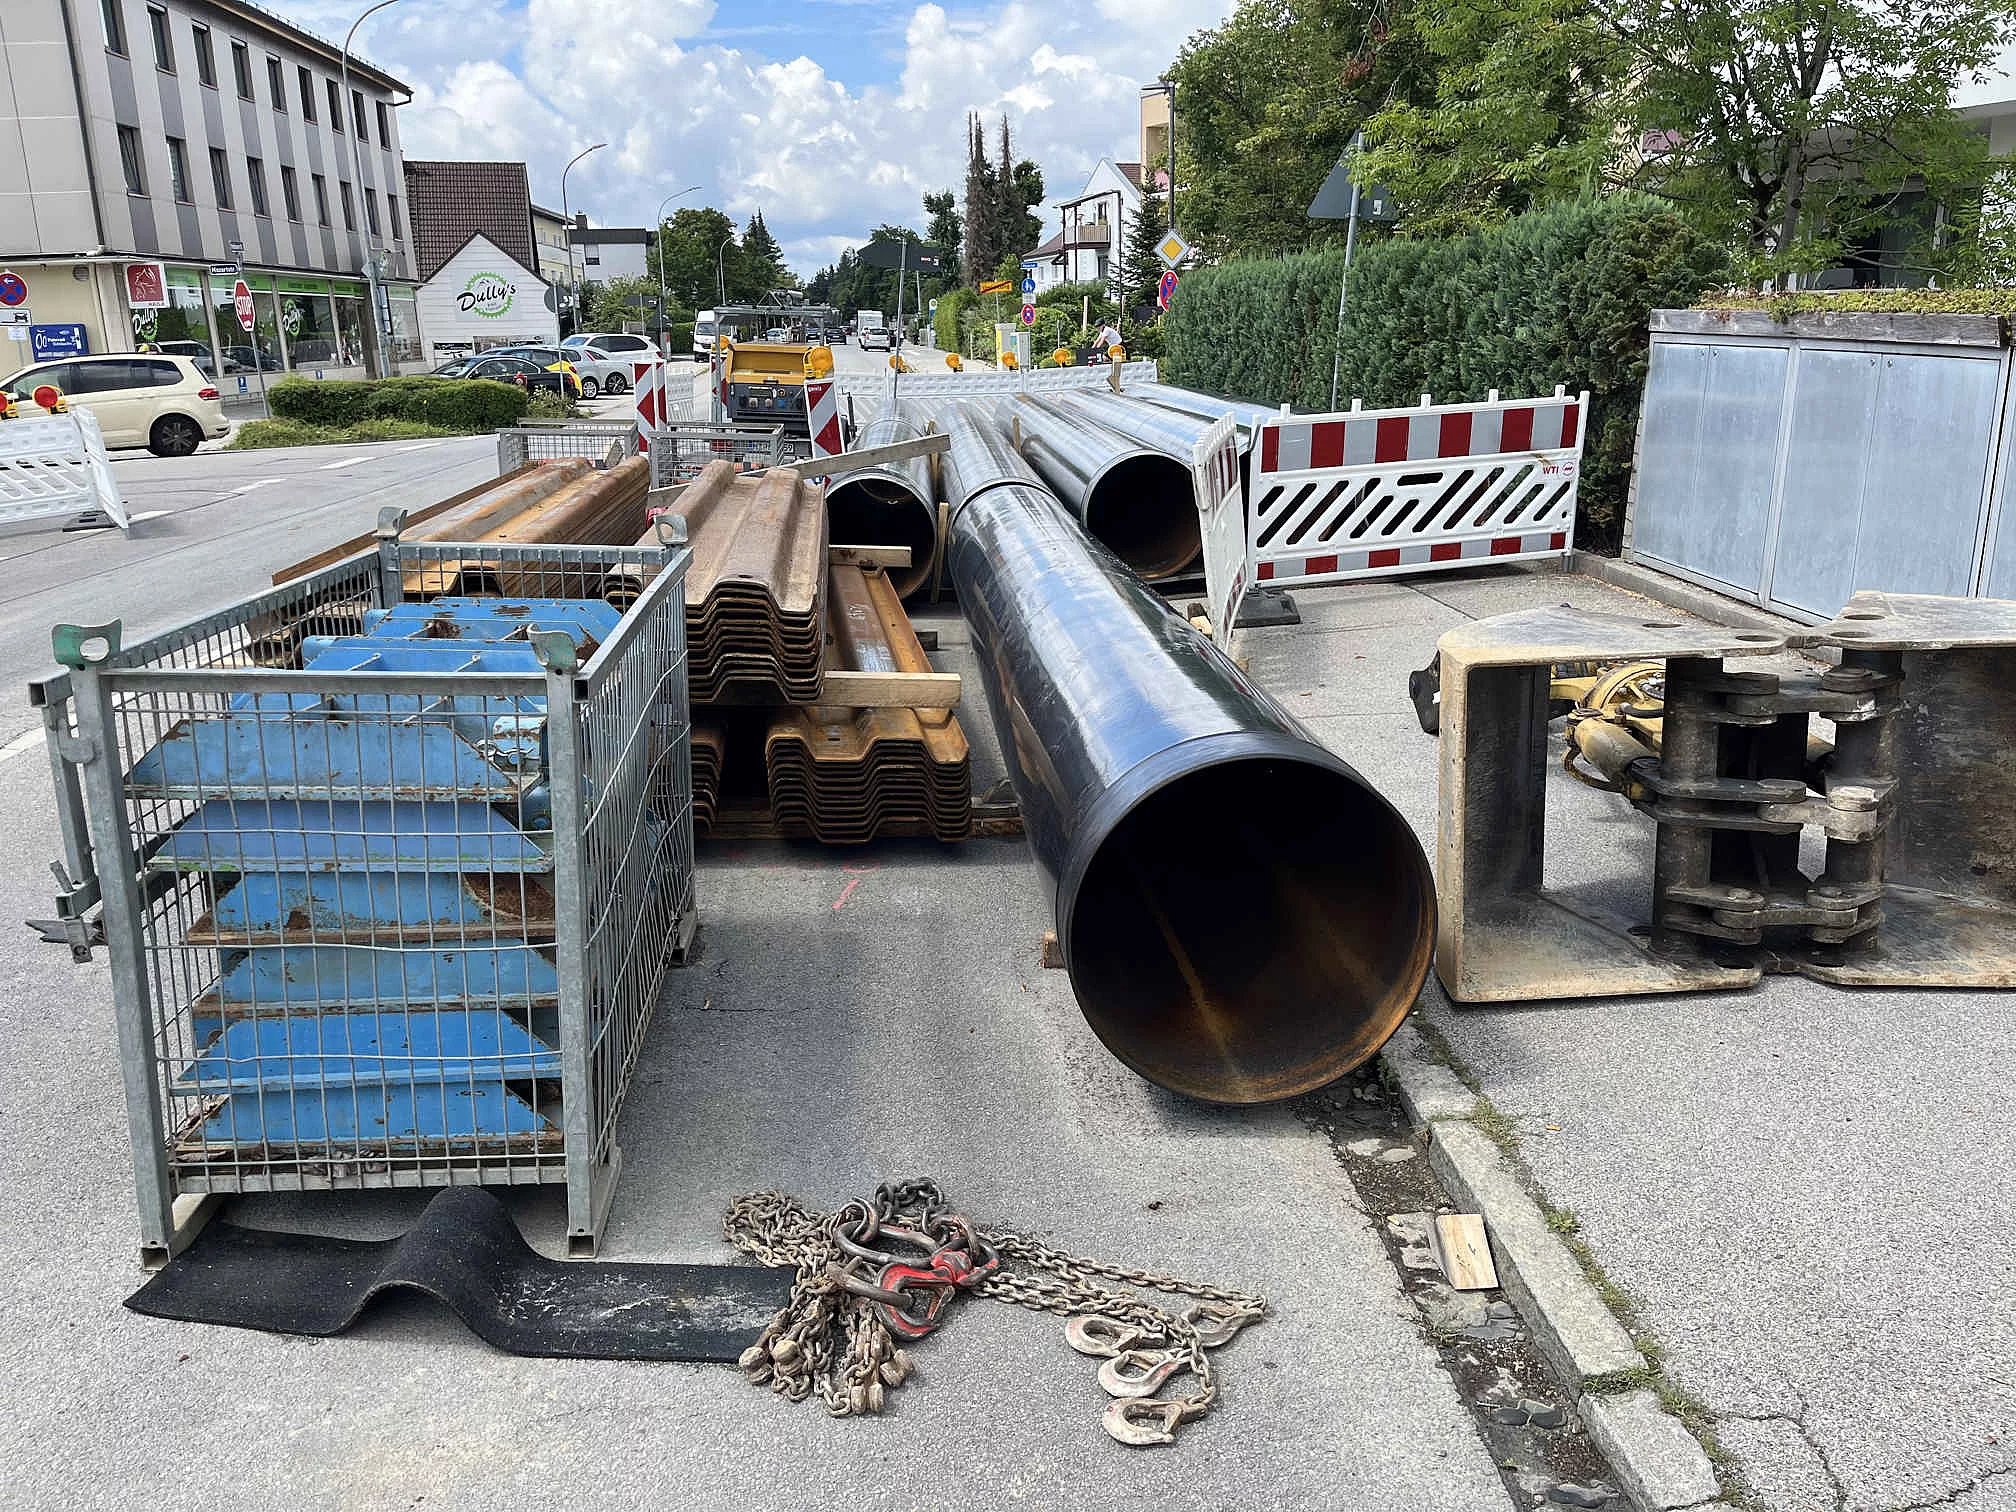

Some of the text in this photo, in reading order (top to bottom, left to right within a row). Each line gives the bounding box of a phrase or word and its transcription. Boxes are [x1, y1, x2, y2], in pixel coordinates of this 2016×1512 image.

[236, 295, 252, 315] STOP
[456, 284, 516, 311] Dully's
[132, 308, 158, 334] Dullys
[1543, 465, 1559, 475] WTI
